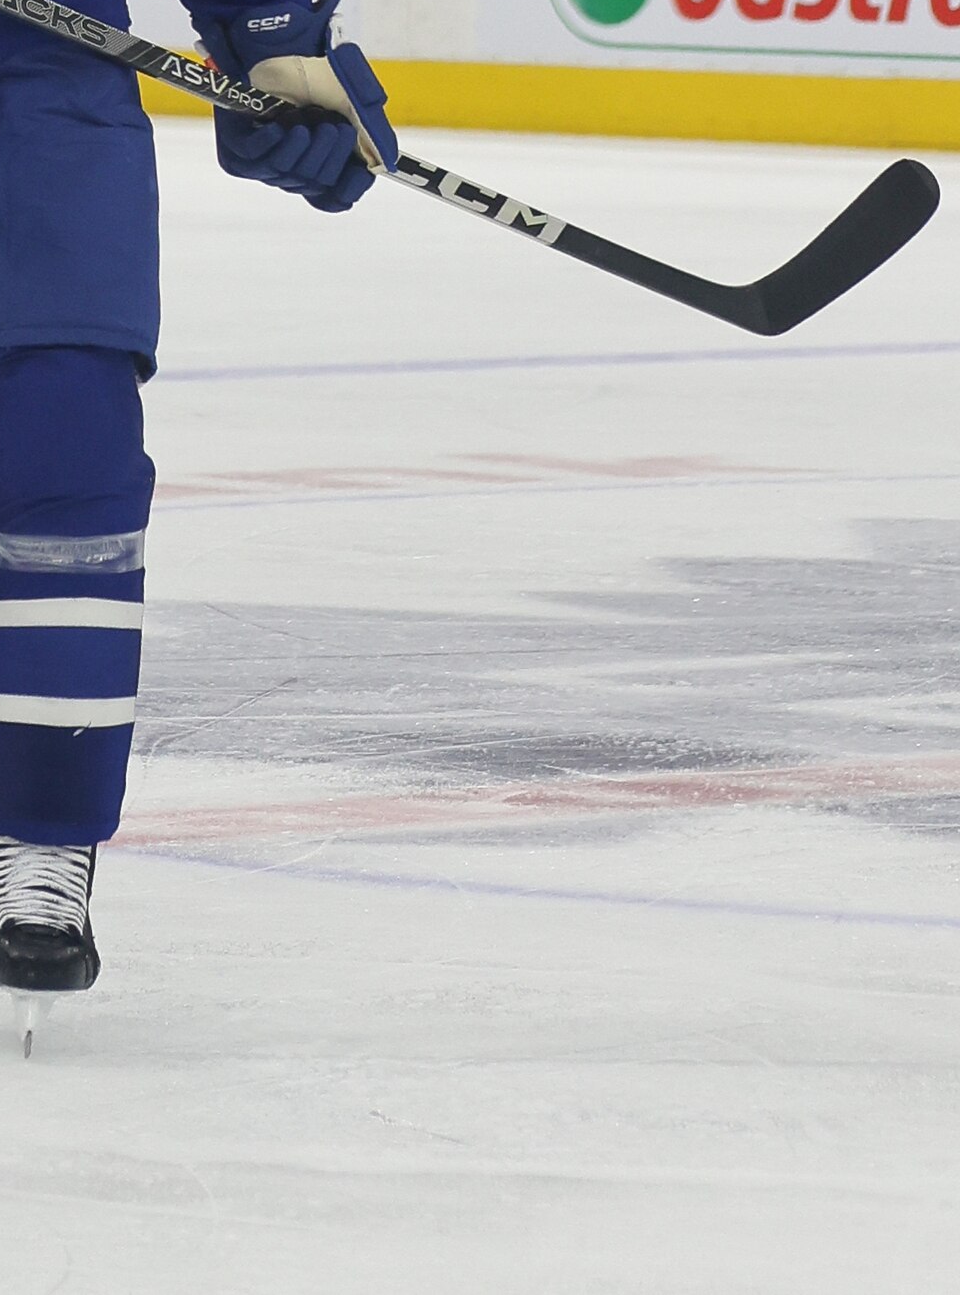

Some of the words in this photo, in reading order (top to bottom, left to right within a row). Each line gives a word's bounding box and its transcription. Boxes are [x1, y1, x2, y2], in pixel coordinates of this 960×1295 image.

[247, 13, 292, 29] CCM
[228, 86, 264, 112] PRO
[395, 162, 567, 245] CCM
